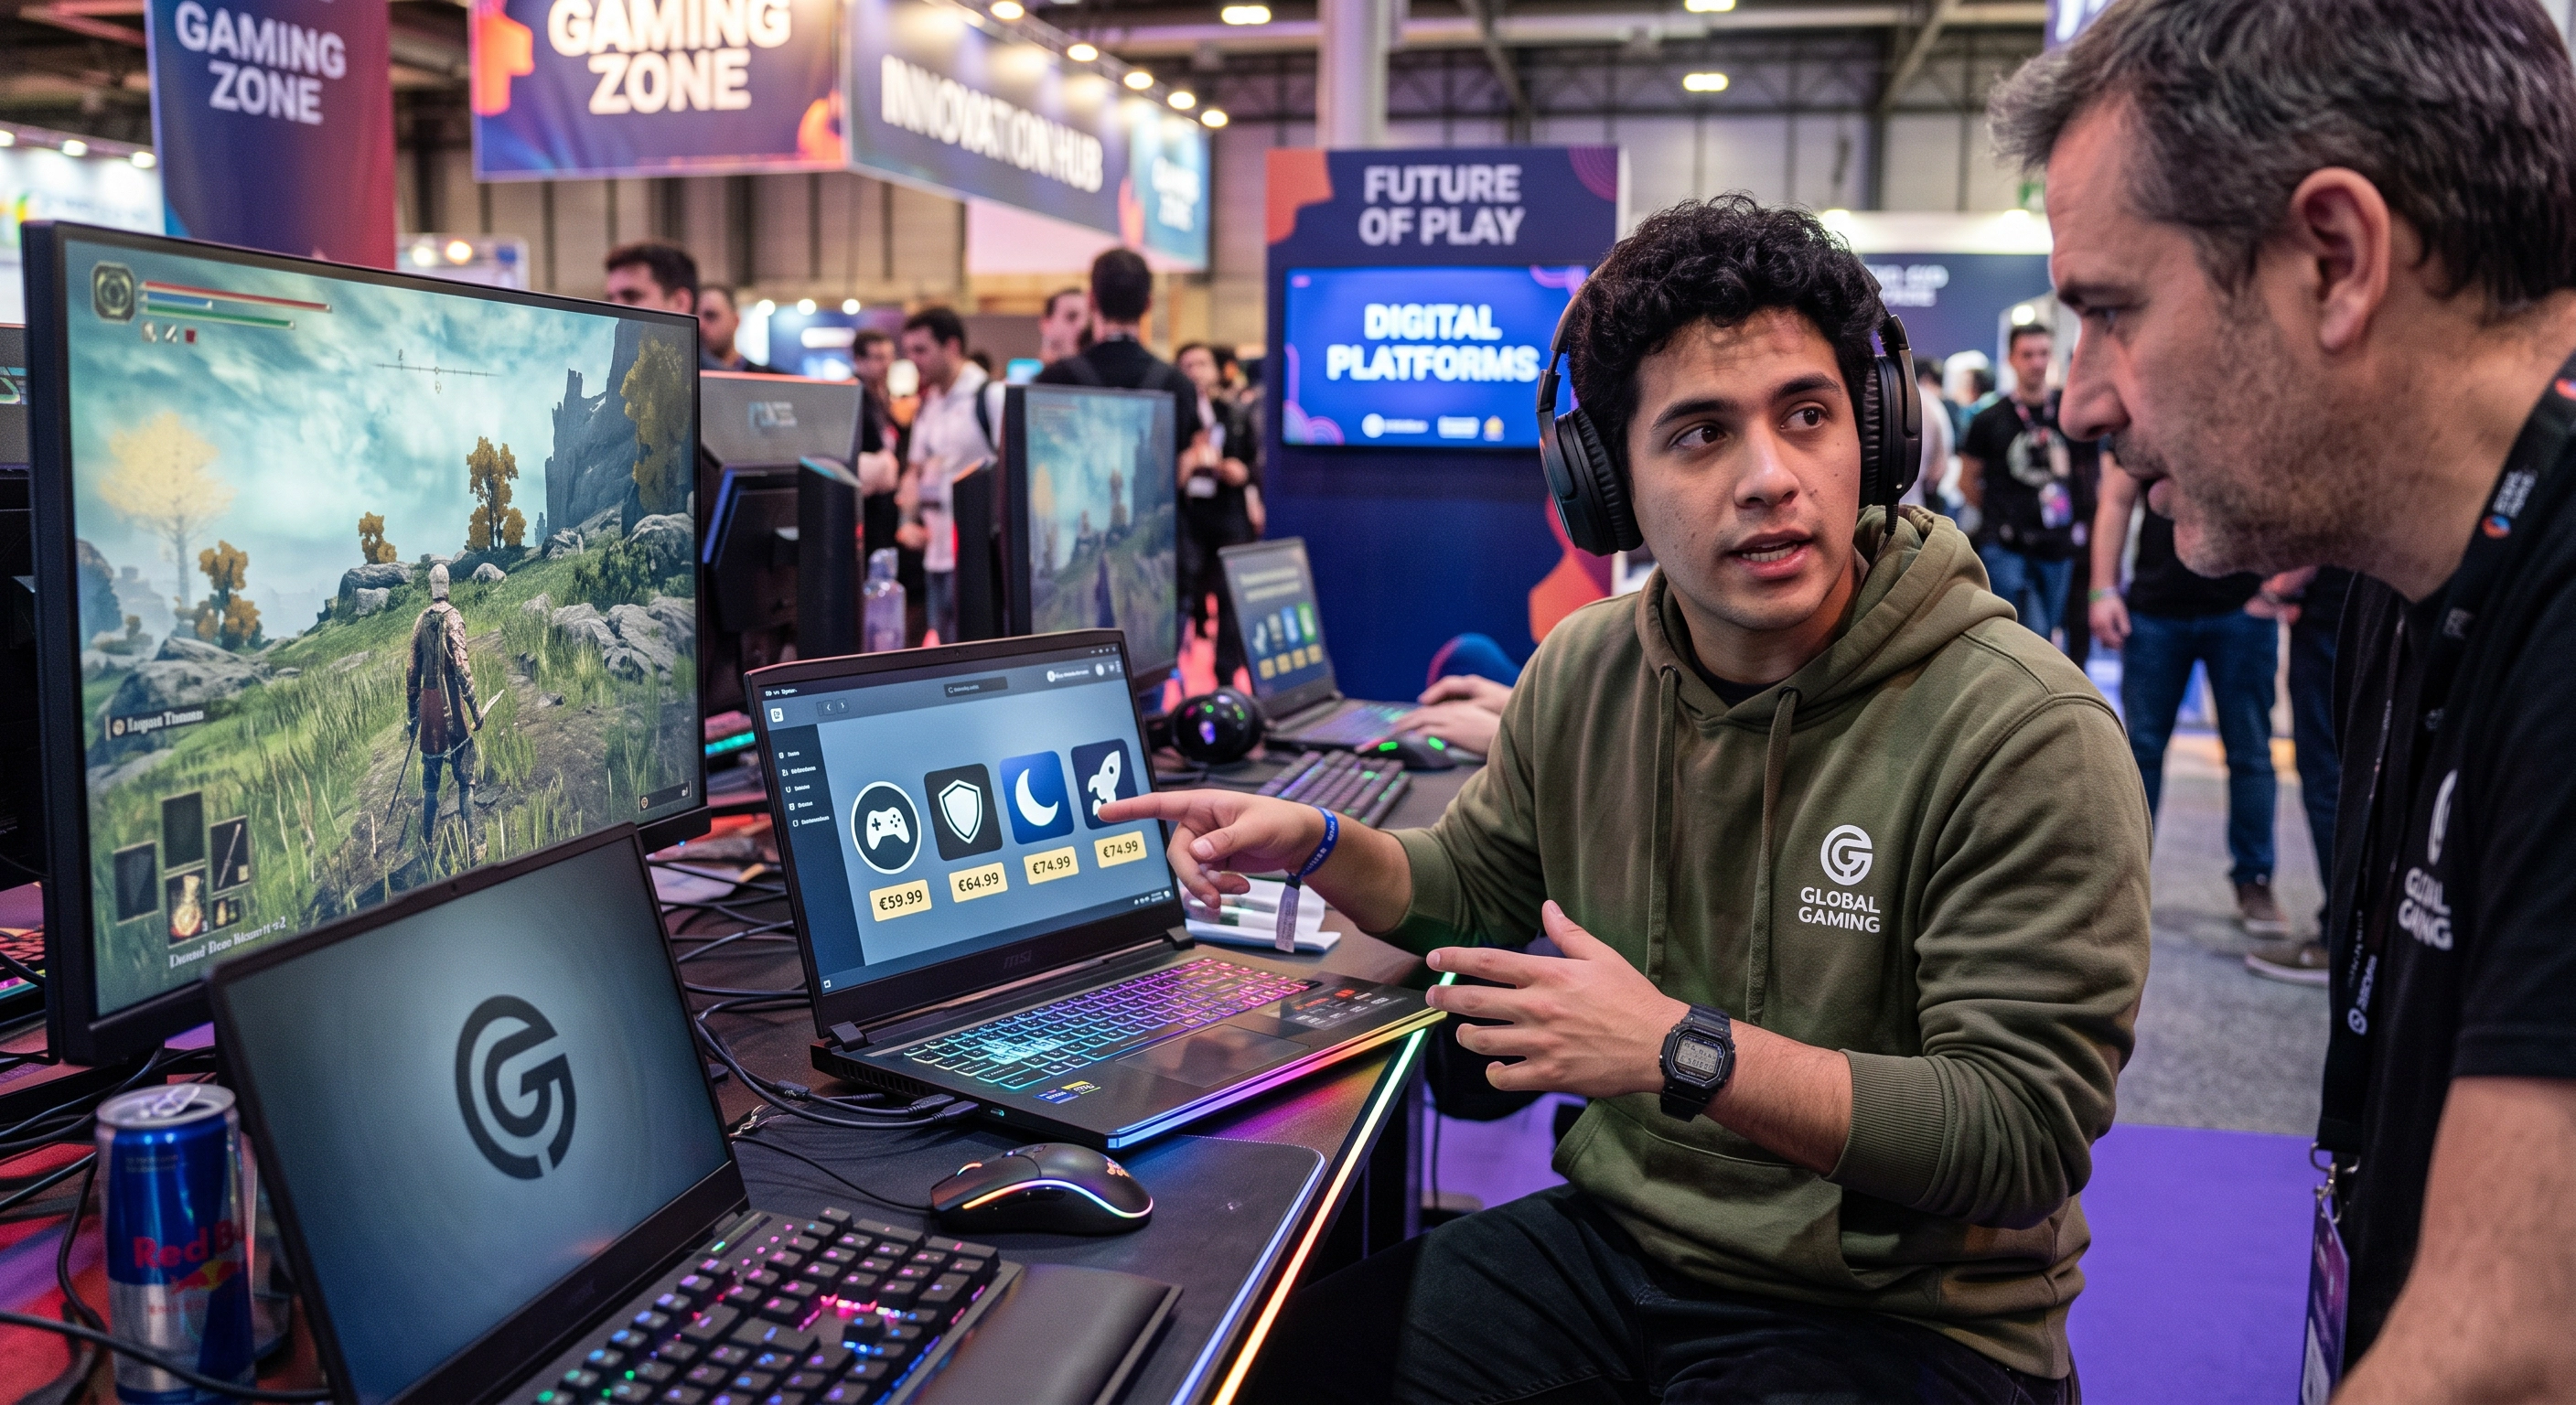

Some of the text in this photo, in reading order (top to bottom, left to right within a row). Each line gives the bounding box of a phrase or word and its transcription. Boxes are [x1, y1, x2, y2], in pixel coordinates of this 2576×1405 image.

[175, 1, 347, 80] GAMING
[548, 0, 791, 57] GAMING
[208, 59, 324, 125] ZONE
[587, 48, 752, 114] ZONE
[881, 54, 1052, 177] INNOVATION
[1052, 122, 1103, 193] HUB
[1364, 164, 1522, 204] FUTURE
[1358, 206, 1527, 246] OF PLAY
[1364, 303, 1503, 340] DIGITAL
[1326, 344, 1540, 382] PLATFORMS
[879, 840, 1139, 911] €59.99 €64.99 €74.99 €74.99
[1798, 906, 1881, 933] GAMING
[1800, 886, 1881, 914] GLOBAL
[133, 1227, 209, 1269] Red
